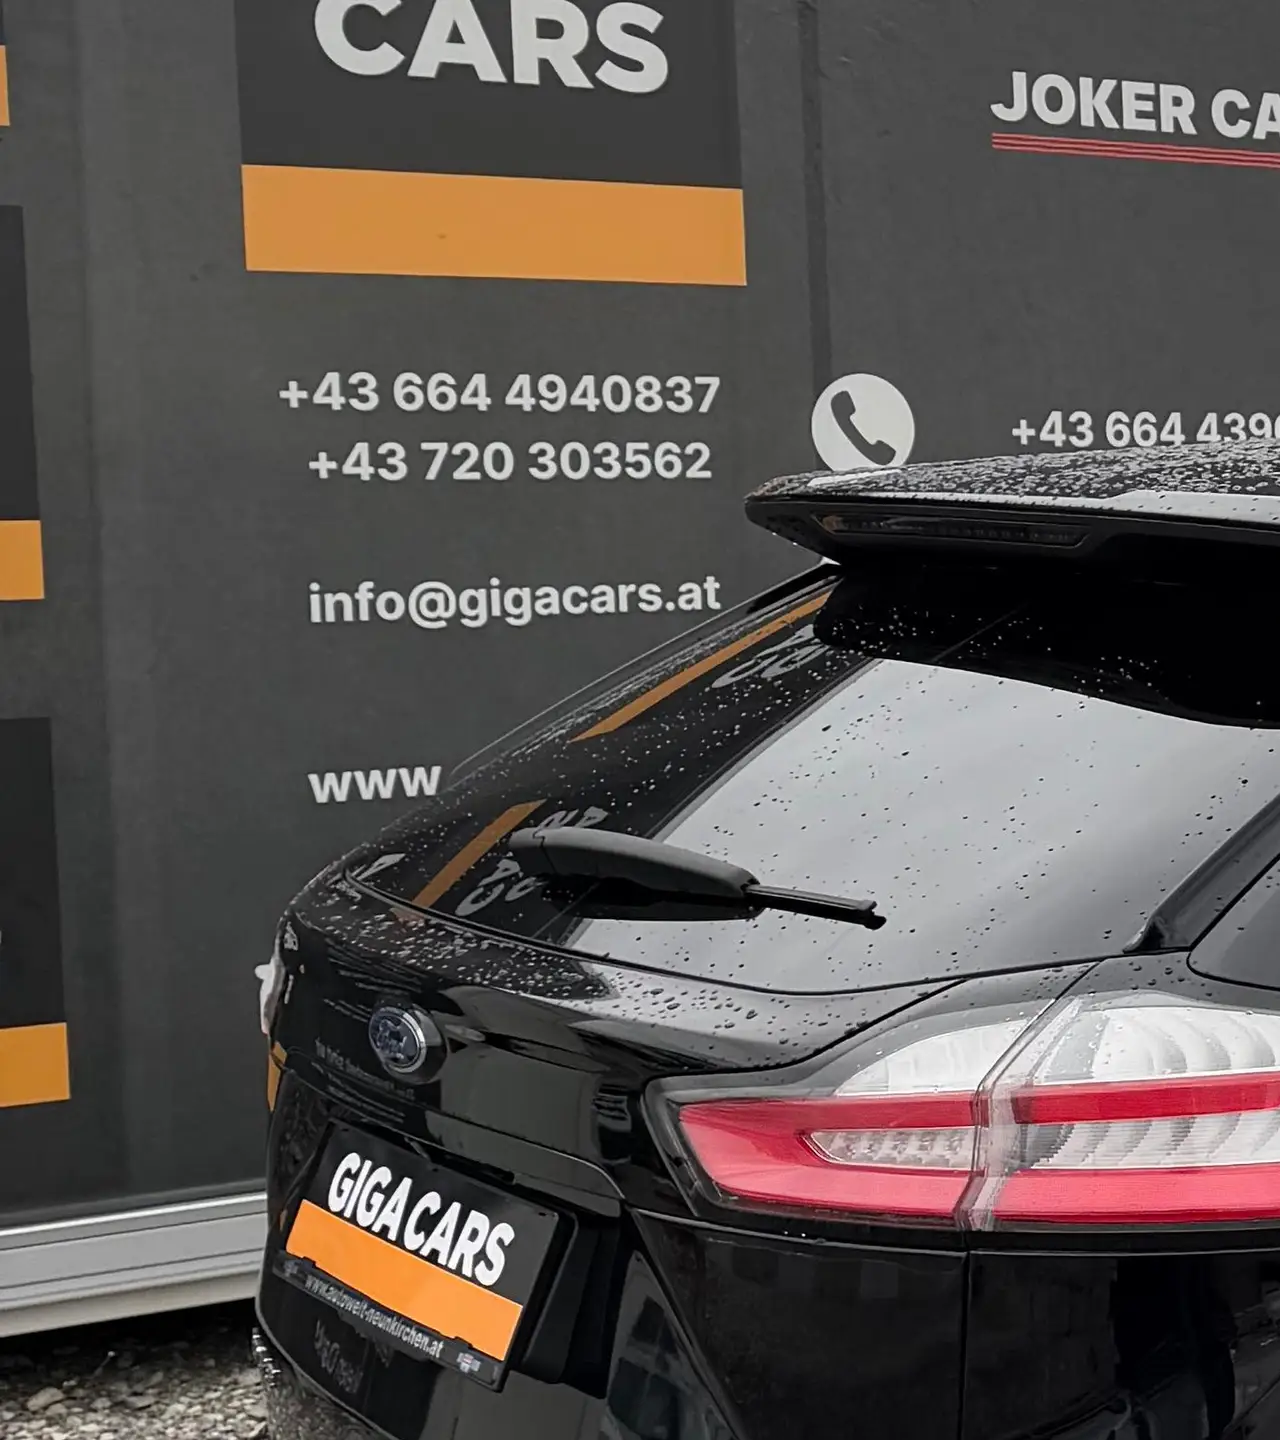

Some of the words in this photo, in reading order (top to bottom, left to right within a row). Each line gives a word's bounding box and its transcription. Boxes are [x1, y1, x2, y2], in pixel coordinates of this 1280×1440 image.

[315, 0, 669, 93] CARS
[991, 71, 1197, 134] JOKER
[280, 372, 380, 411] +43
[394, 373, 491, 411] 664
[506, 373, 720, 413] 4940837
[1012, 411, 1094, 447] +43
[1106, 411, 1185, 447] 664
[309, 442, 408, 481] +43
[421, 442, 514, 481] 720
[529, 442, 712, 481] 303562
[309, 576, 722, 629] info@gigacars.at
[328, 1152, 412, 1241] GIGA
[403, 1191, 515, 1286] CARS
